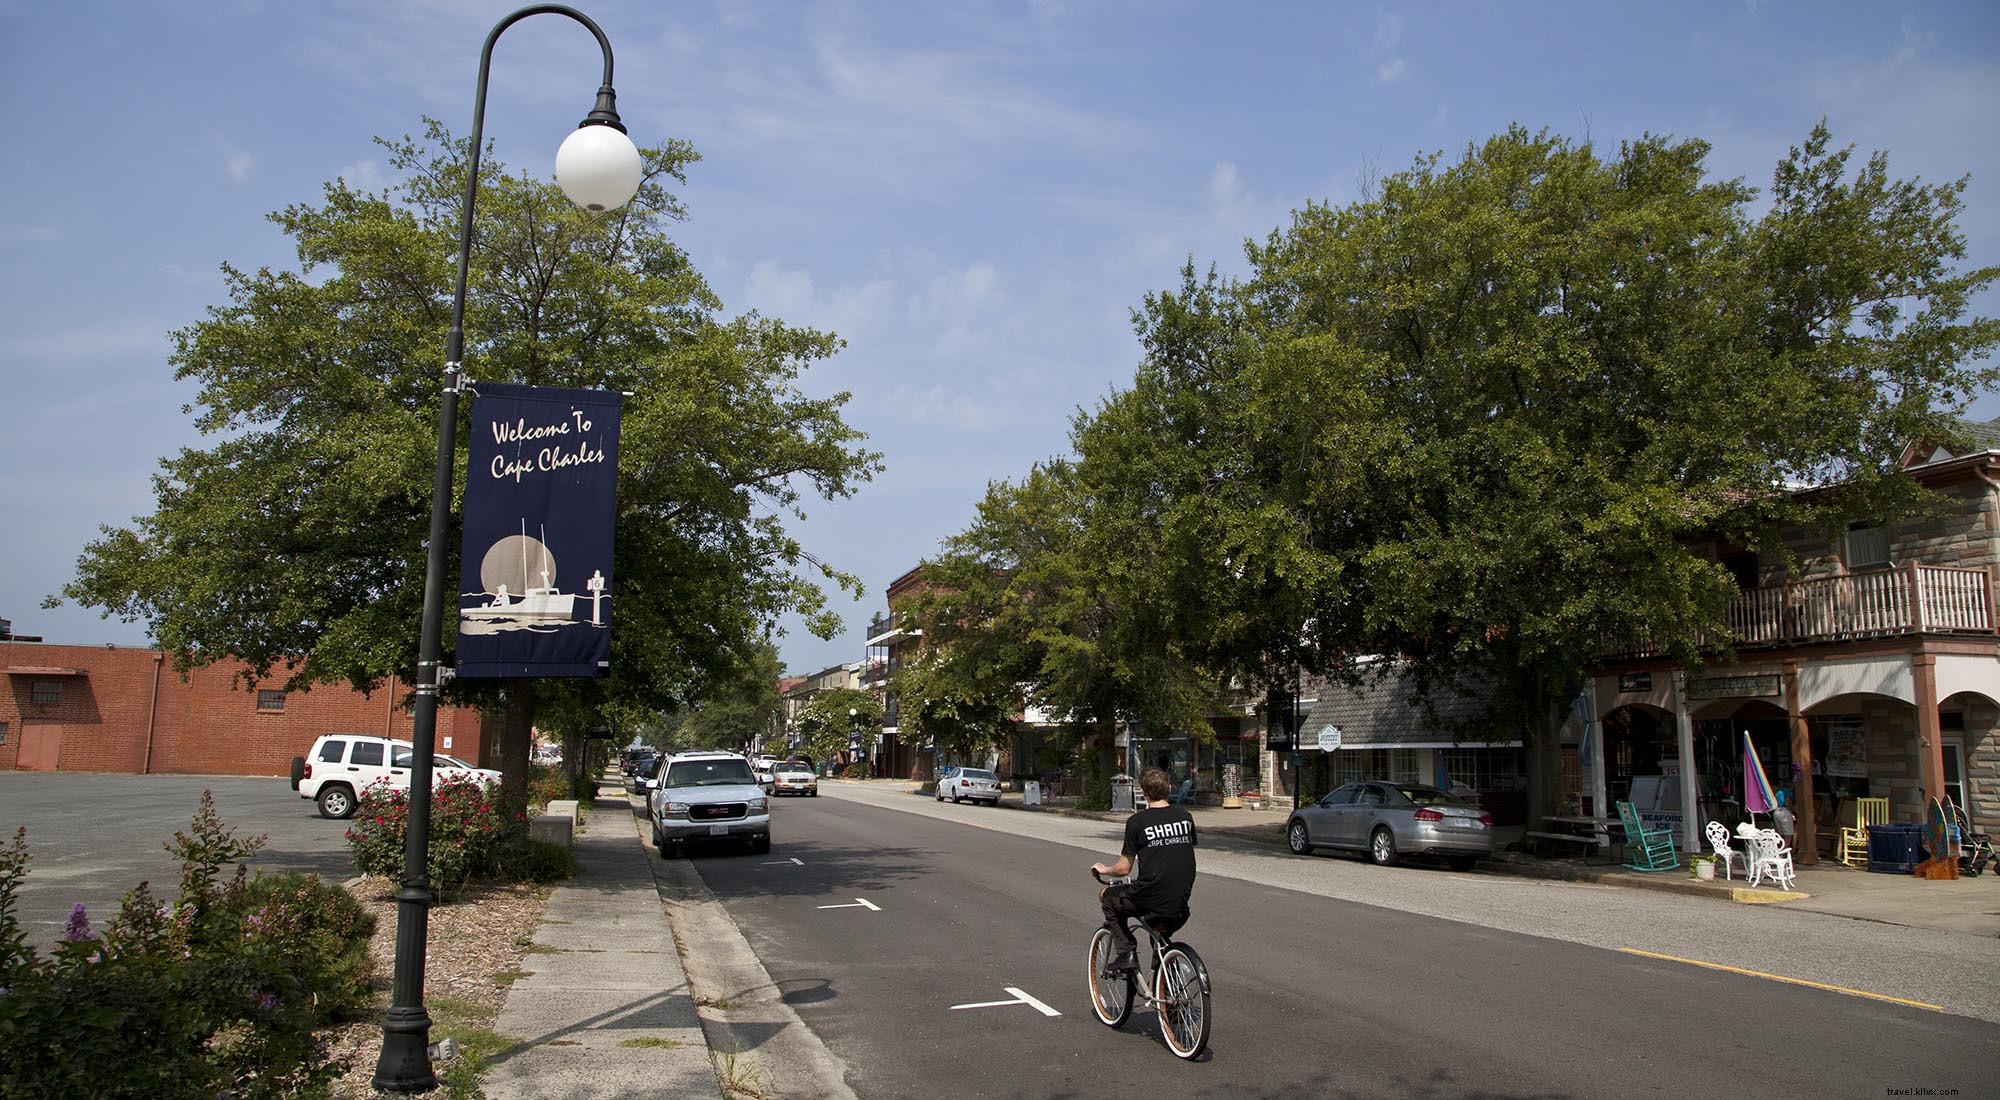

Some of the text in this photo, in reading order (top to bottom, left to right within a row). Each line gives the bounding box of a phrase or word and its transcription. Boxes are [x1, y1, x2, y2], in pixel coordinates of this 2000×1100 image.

[492, 411, 592, 445] Welcome To
[491, 441, 604, 483] Cape Charles
[1642, 814, 1683, 822] SEAFORD
[1655, 822, 1671, 830] ICE
